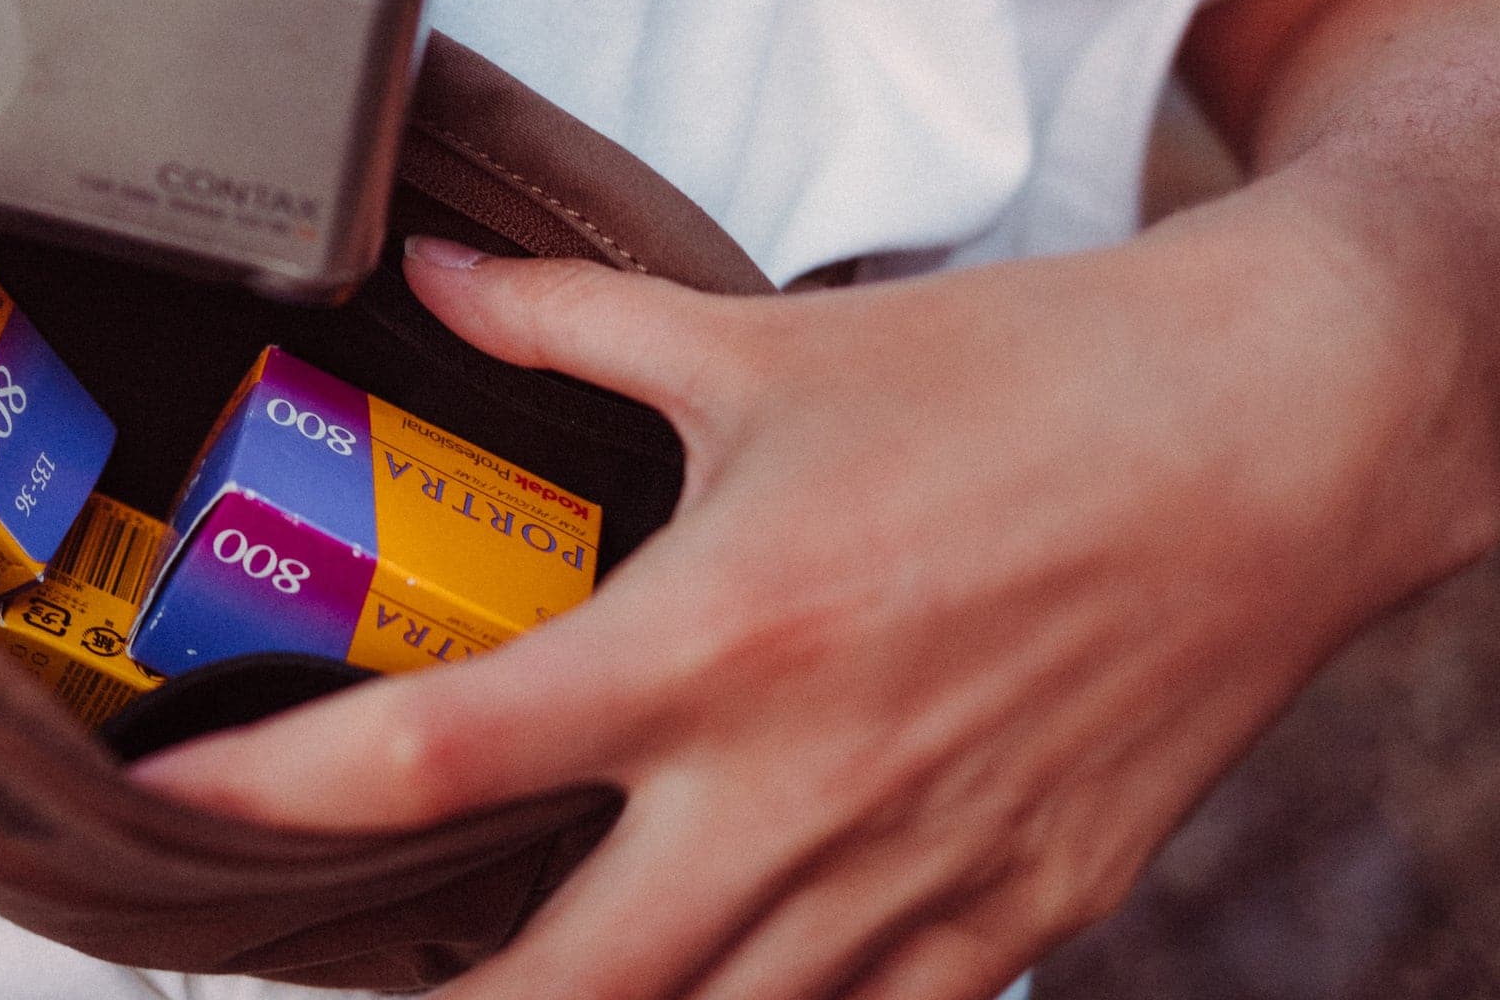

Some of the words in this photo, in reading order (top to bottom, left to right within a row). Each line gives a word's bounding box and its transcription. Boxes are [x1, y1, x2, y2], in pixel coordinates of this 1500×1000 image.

[265, 397, 358, 457] 800
[401, 417, 511, 481] Professional
[14, 451, 57, 518] 135-36
[384, 451, 586, 573] PORTRA
[514, 472, 590, 521] Kodak
[212, 528, 311, 594] 800
